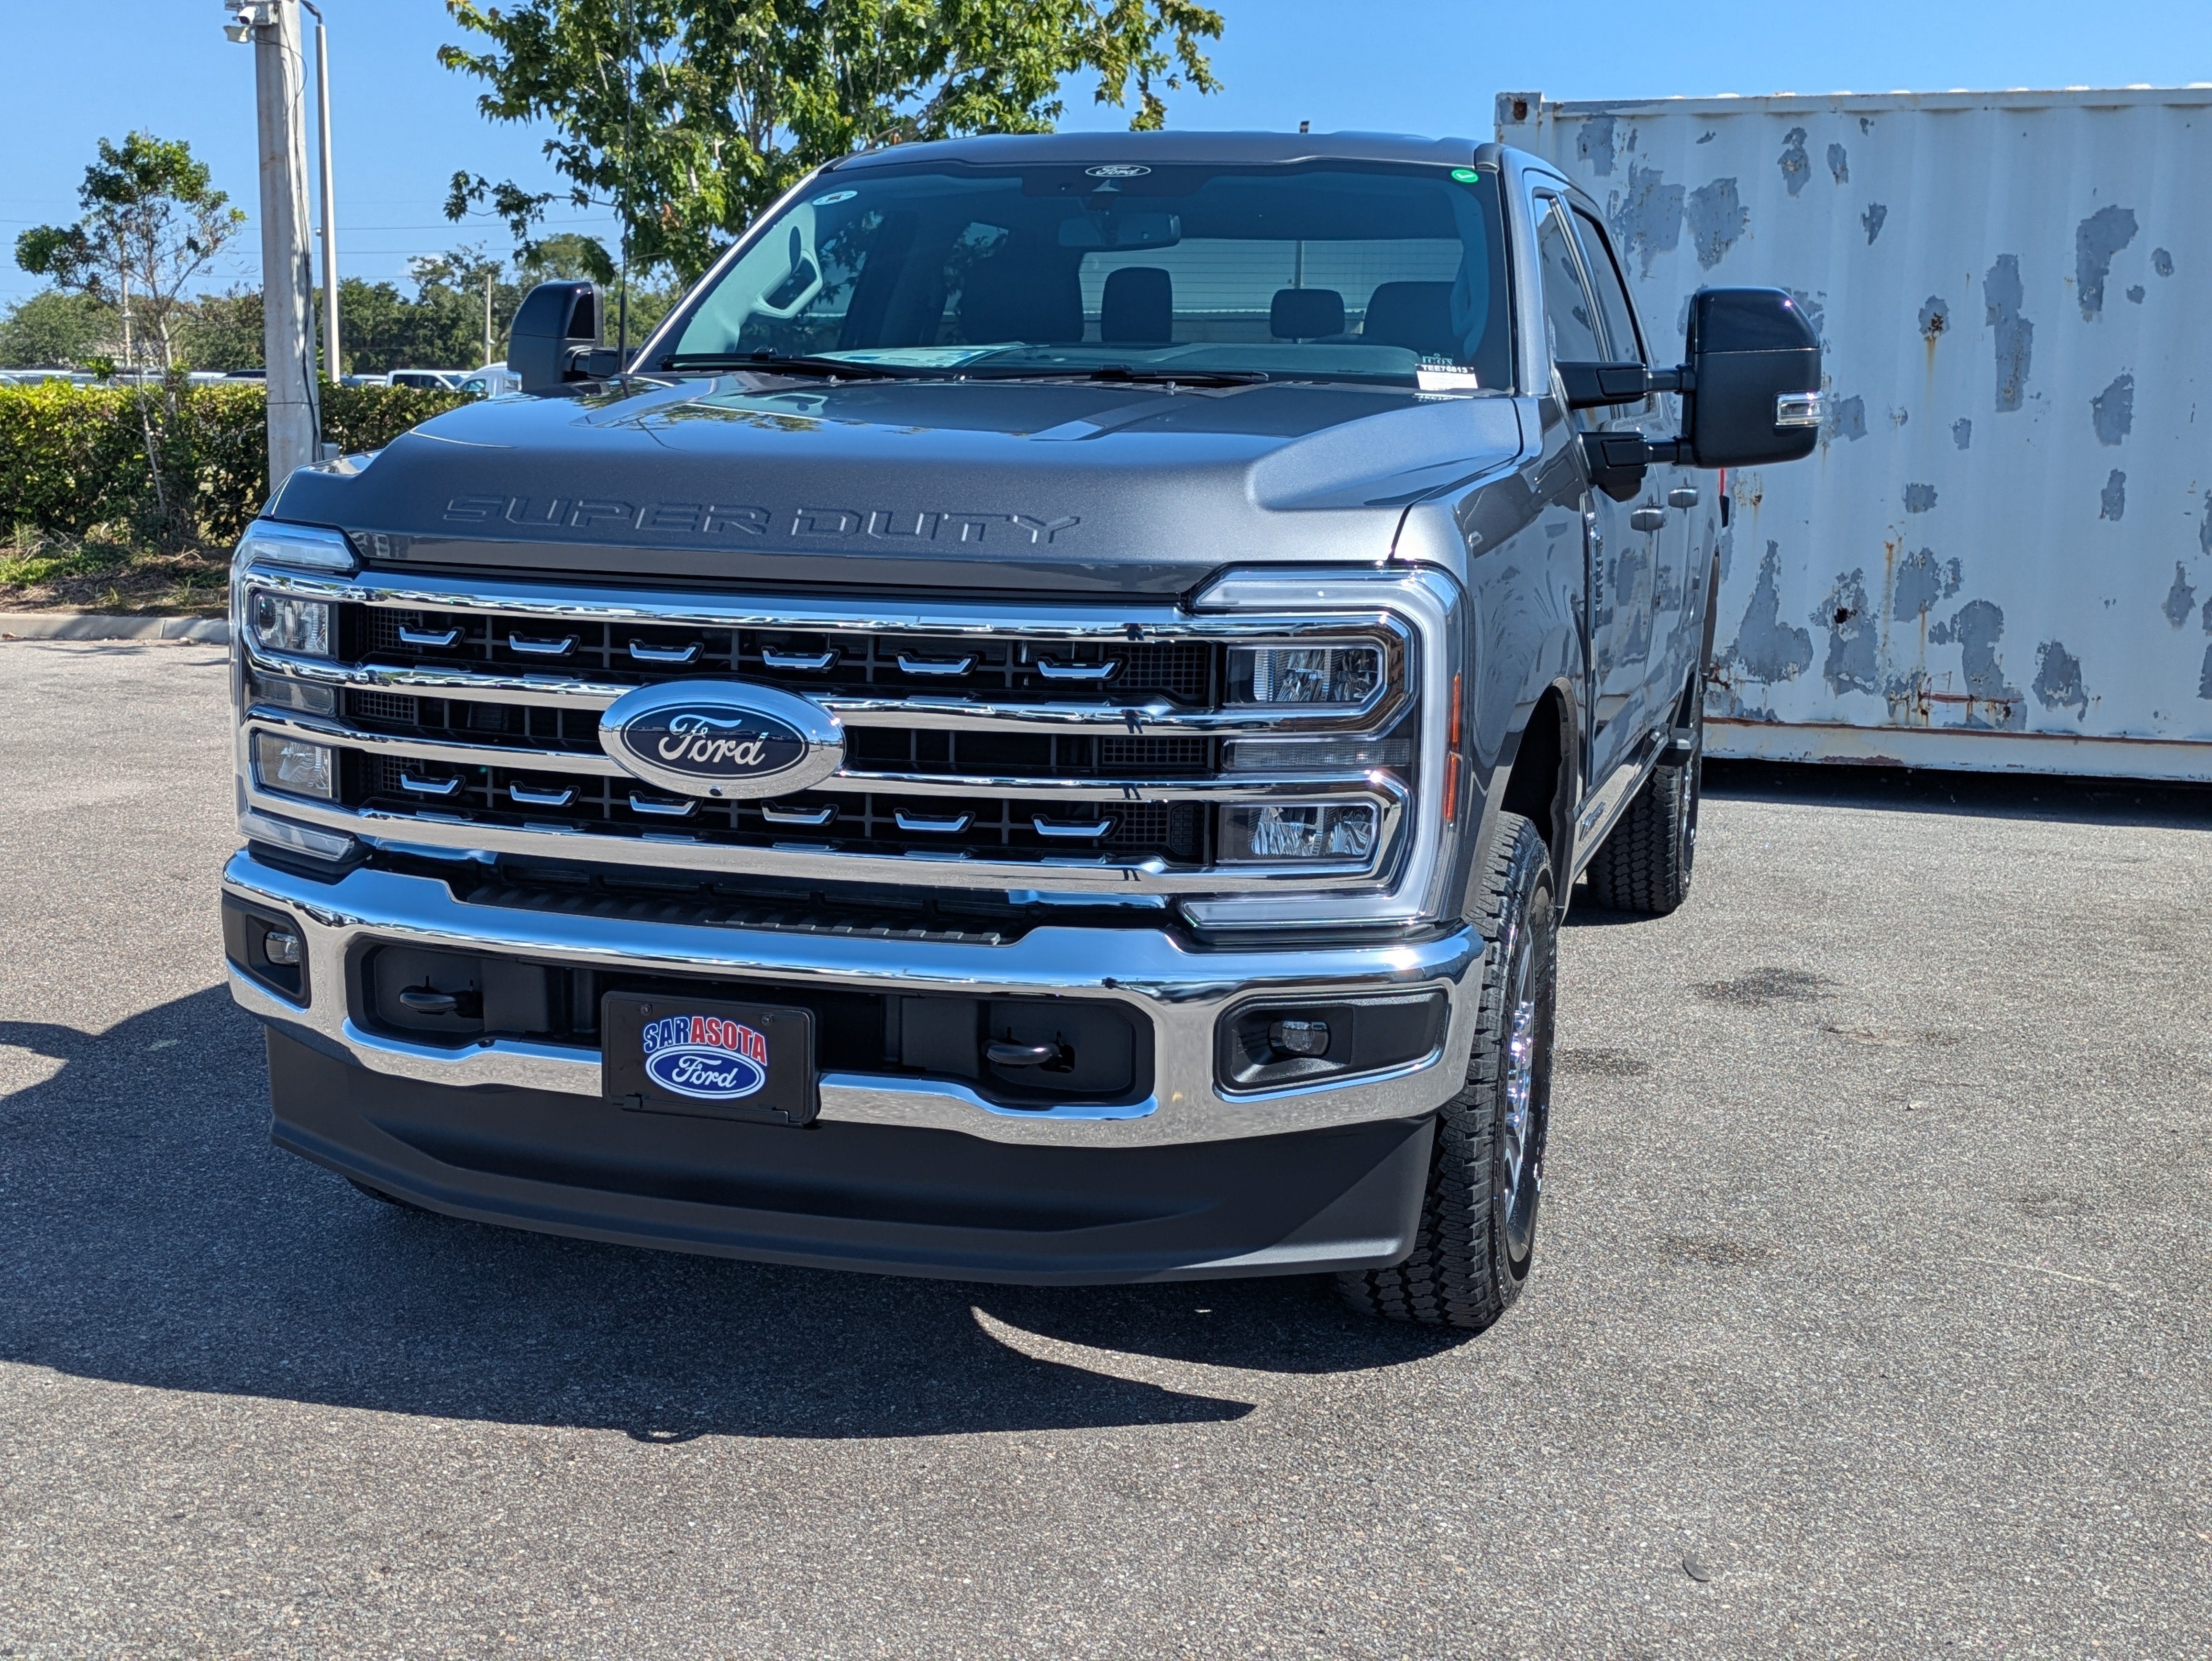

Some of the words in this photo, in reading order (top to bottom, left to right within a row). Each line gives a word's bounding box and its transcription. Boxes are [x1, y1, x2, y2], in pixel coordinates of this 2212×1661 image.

[1096, 166, 1140, 175] Ford
[443, 494, 772, 534] SUPER
[791, 508, 1081, 543] DUTY
[658, 713, 769, 766] Ford
[643, 1016, 767, 1066] SARASOTA
[672, 1055, 739, 1088] Ford
